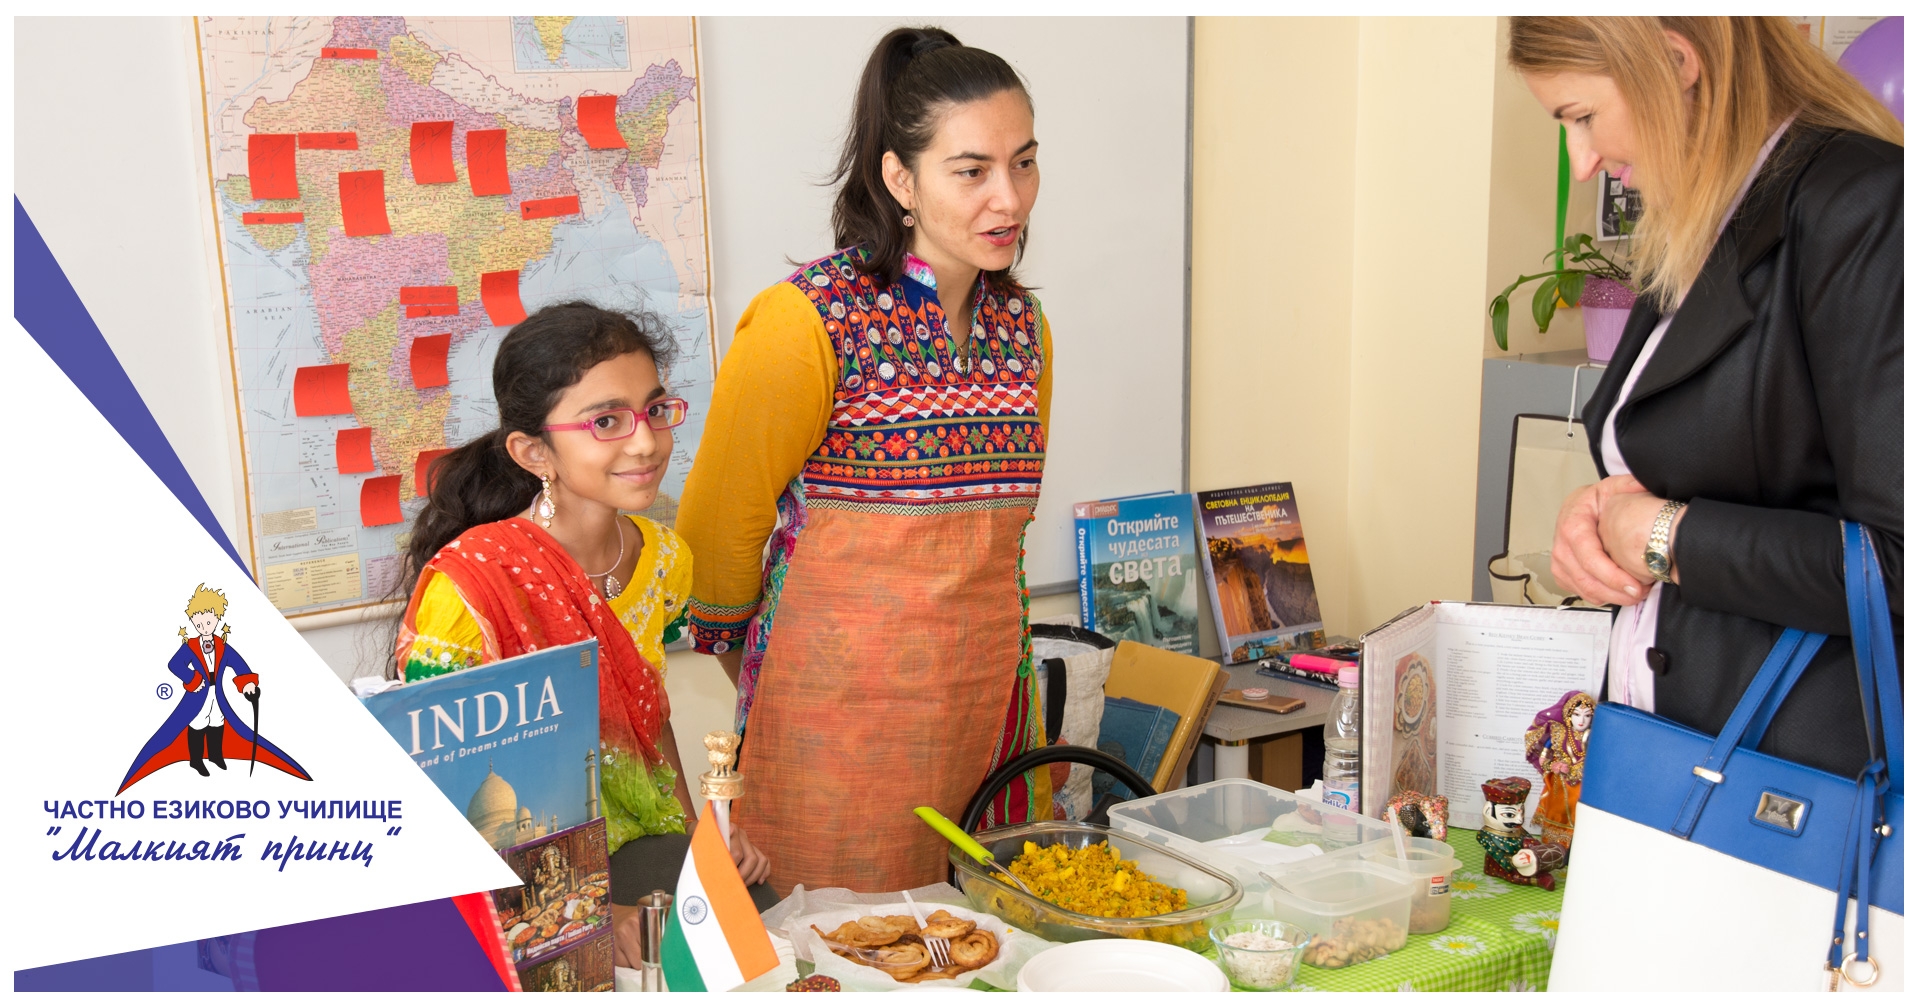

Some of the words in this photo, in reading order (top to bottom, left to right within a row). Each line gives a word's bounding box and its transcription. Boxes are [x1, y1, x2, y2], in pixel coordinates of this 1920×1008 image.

[246, 306, 292, 314] ARABIAN
[1205, 499, 1239, 510] СВЕТОВНА
[1239, 492, 1290, 506] ЕНЦИКЛОПЕДИЯ
[1244, 505, 1255, 513] НА
[1107, 513, 1179, 537] Открийте
[1214, 507, 1288, 526] ПЪТЕШЕСТВЕНИКА
[1078, 528, 1087, 576] Открийте
[1108, 534, 1180, 559] чудесата
[1109, 555, 1183, 585] света
[1080, 577, 1090, 624] чудесата
[407, 675, 564, 757] INDIA
[443, 751, 456, 763] of
[459, 740, 498, 758] Dreams
[501, 732, 519, 746] and
[523, 722, 560, 741] Fantasy
